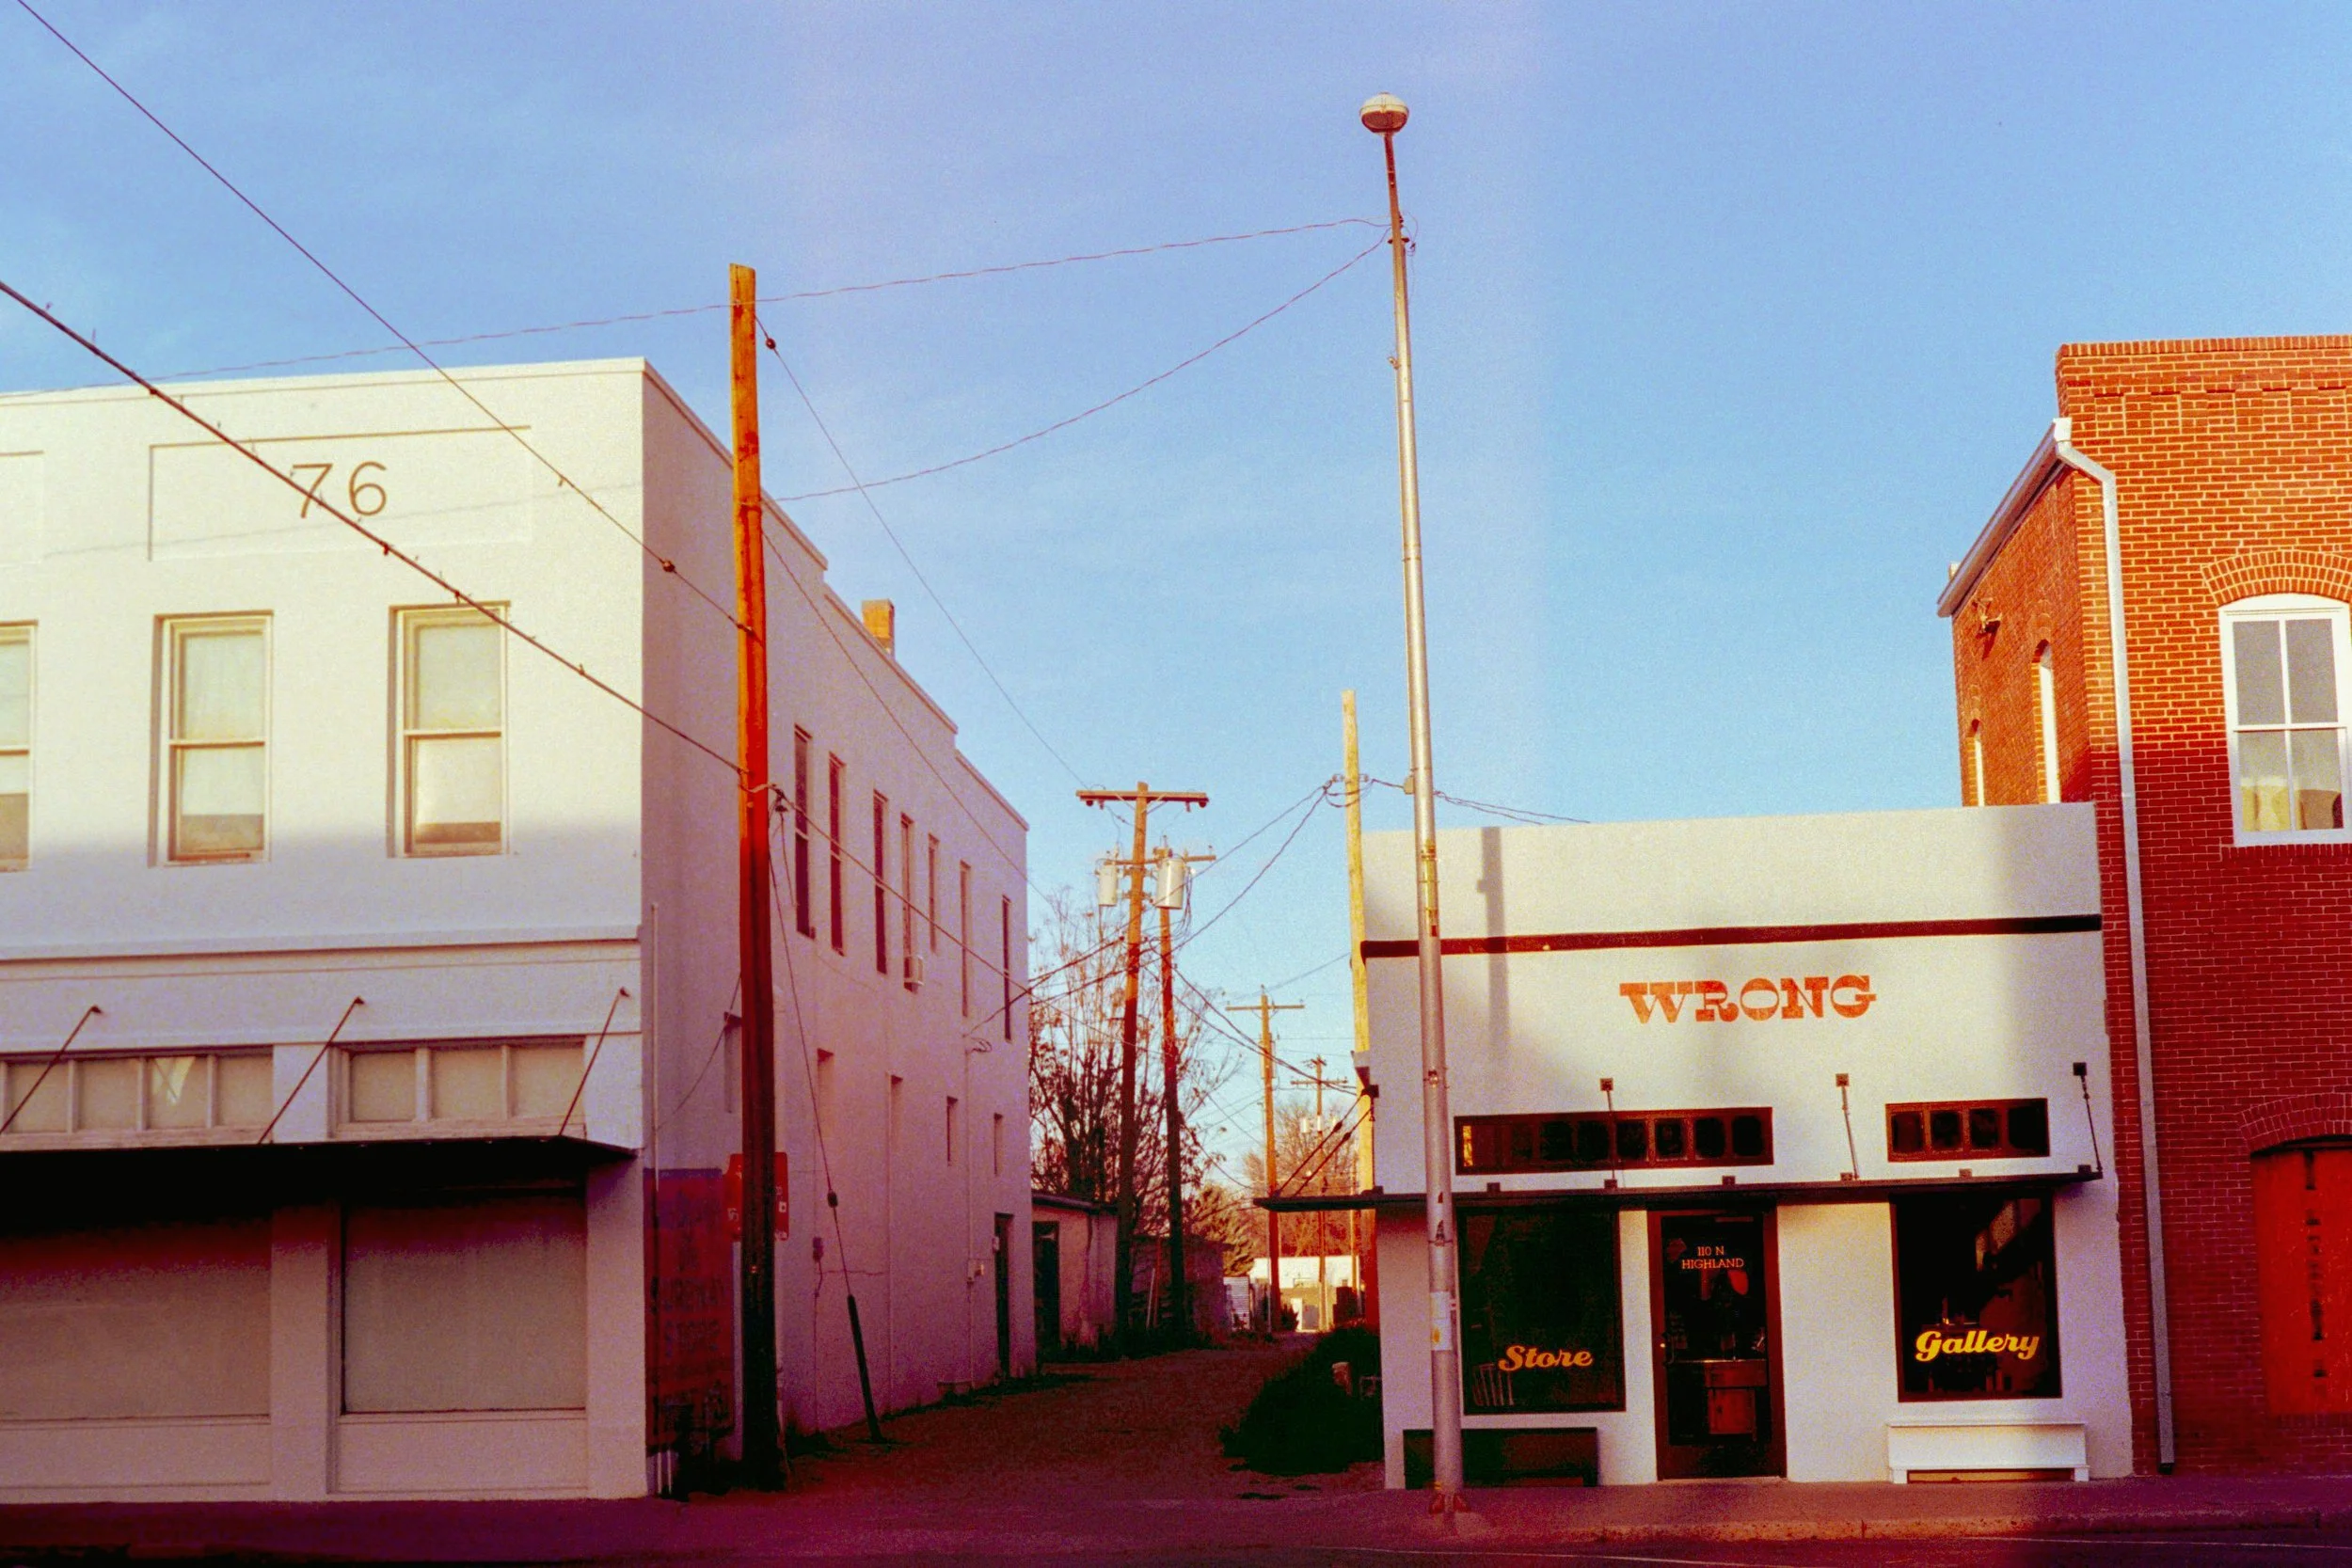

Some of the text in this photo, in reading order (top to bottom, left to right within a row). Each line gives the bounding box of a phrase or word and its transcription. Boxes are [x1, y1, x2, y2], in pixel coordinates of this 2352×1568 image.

[293, 461, 387, 518] 76
[1619, 974, 1877, 1023] WRONG
[1681, 1258, 1744, 1269] HIGHLAND
[1697, 1245, 1724, 1257] 110 N
[1500, 1345, 1593, 1370] Store
[1915, 1330, 2040, 1361] Gallery
